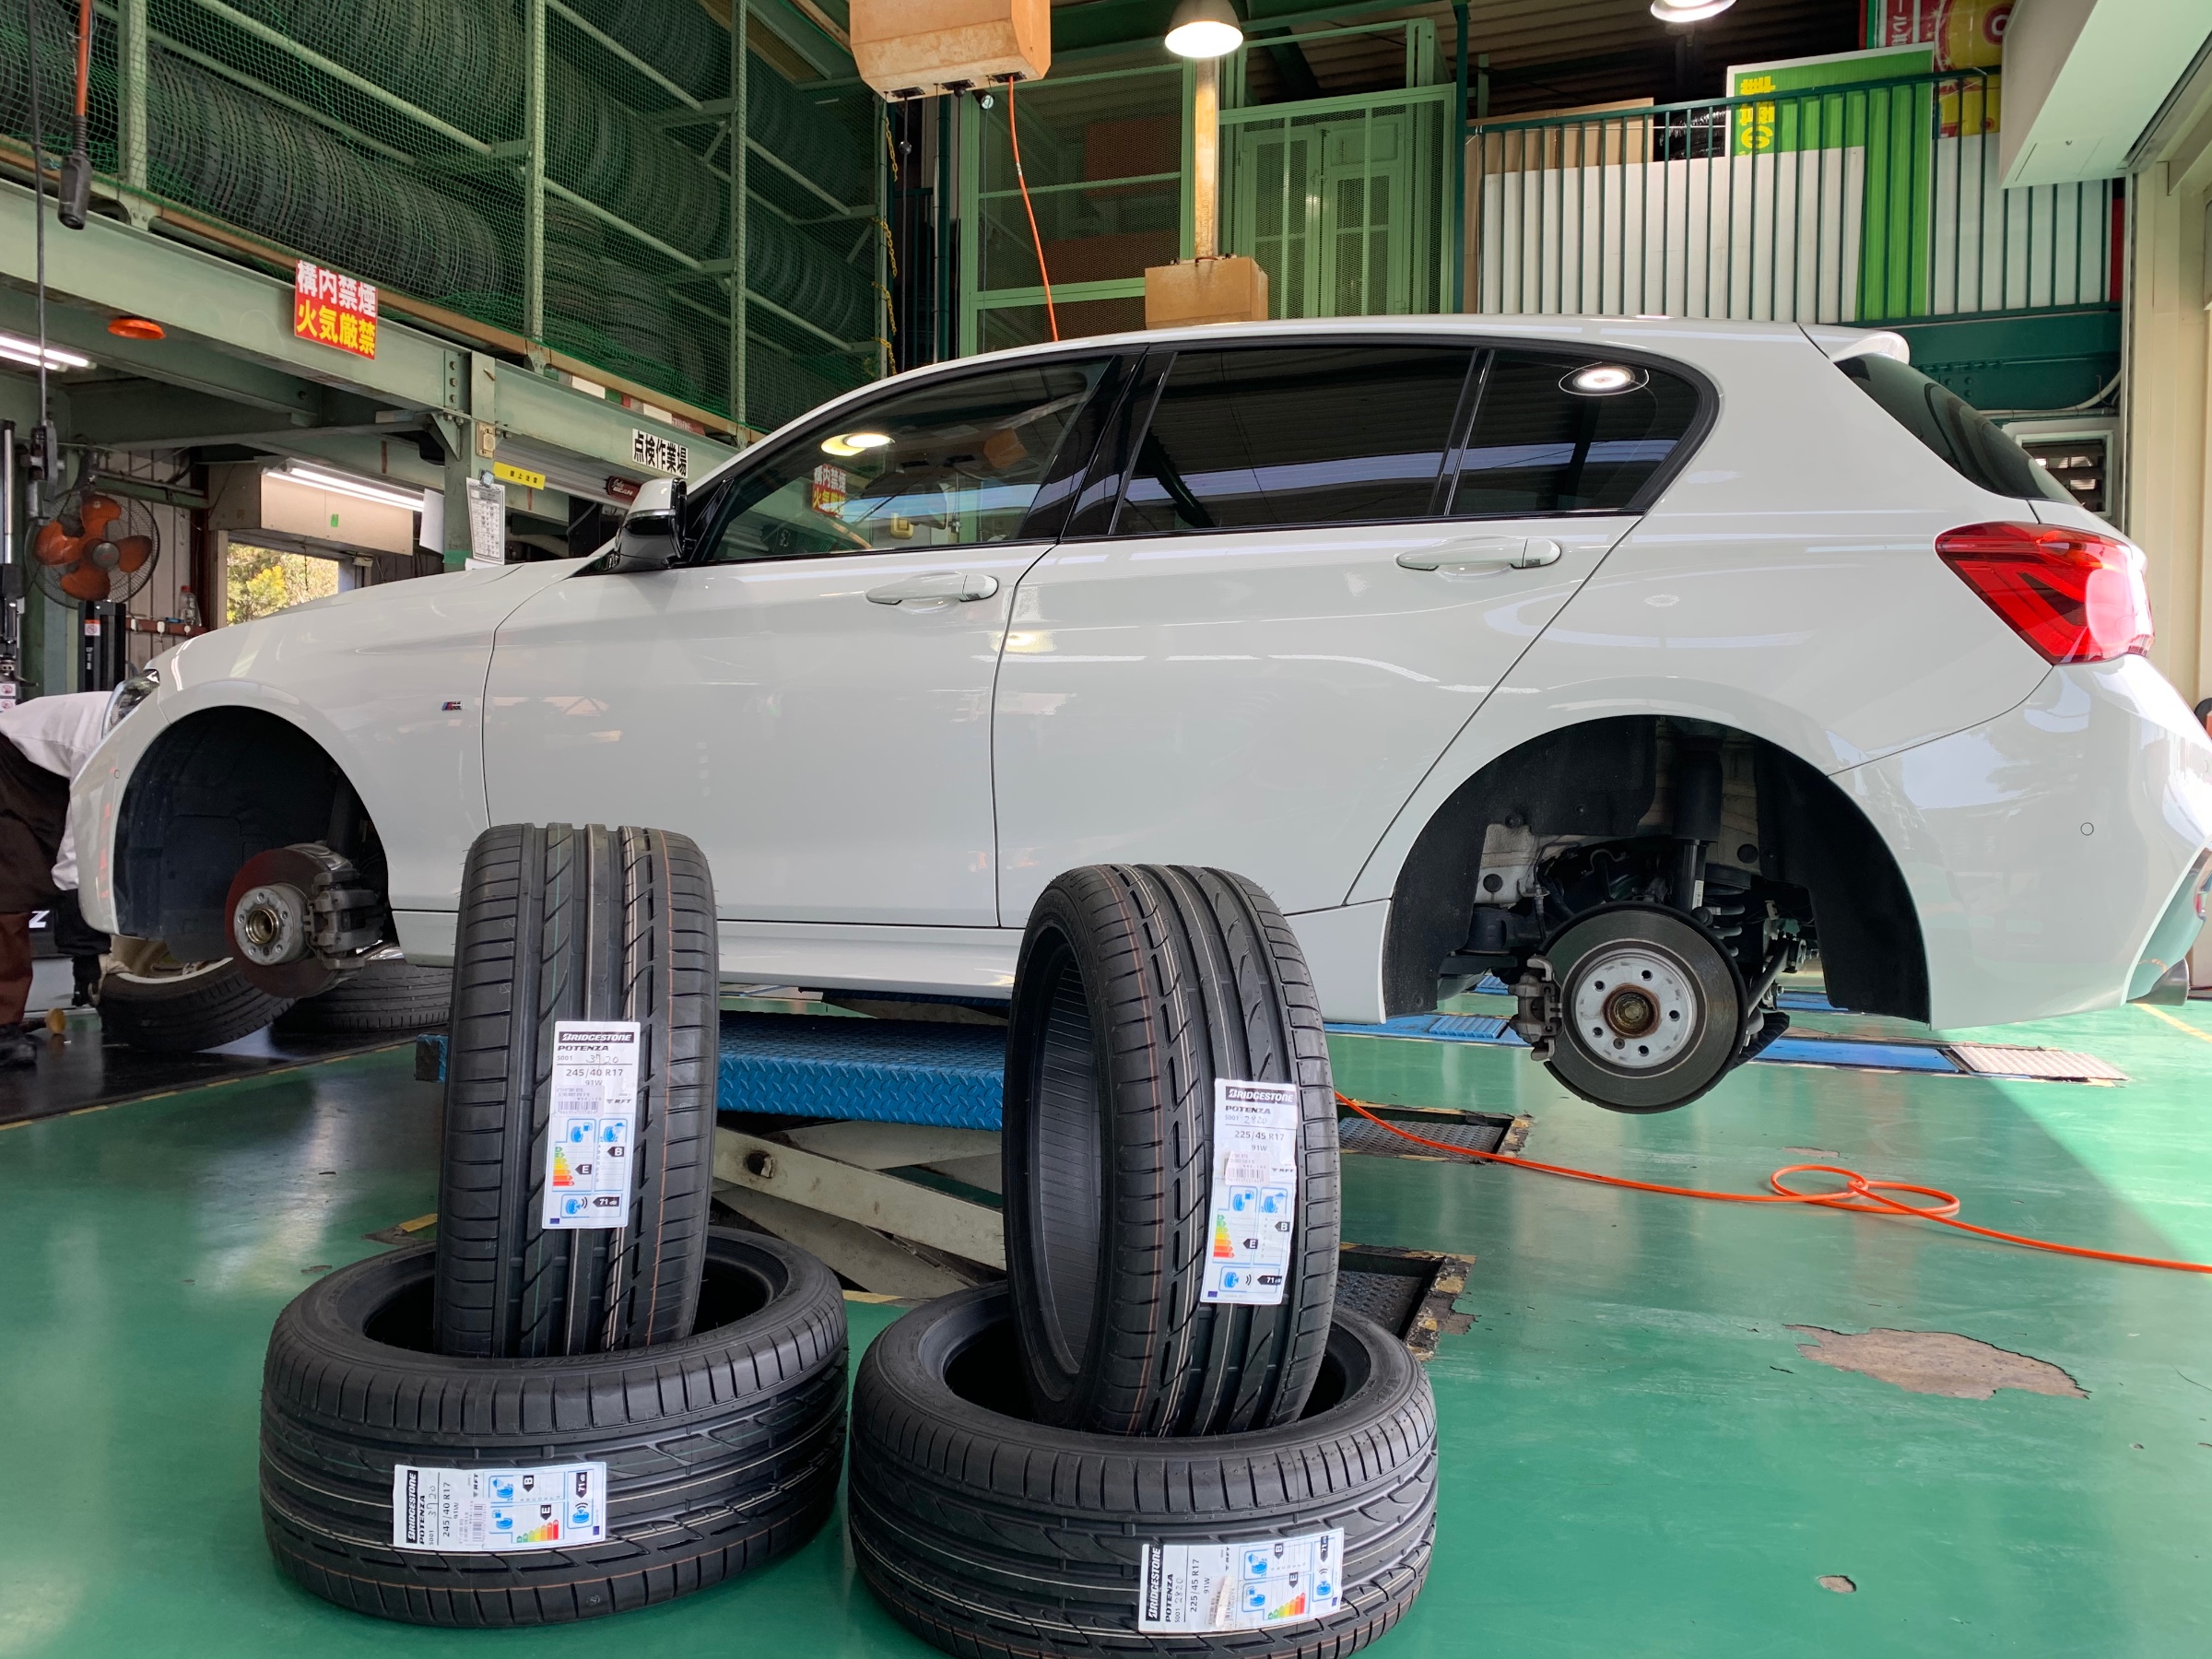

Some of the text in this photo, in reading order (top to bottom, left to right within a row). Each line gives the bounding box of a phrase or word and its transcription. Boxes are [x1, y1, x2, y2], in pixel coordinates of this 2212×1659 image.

[297, 259, 377, 318] 構内禁煙
[296, 299, 376, 356] 火気厳禁
[633, 430, 688, 477] 点検作業場
[561, 1032, 632, 1041] BRIDGESTONE
[566, 1068, 624, 1078] 245/40 R17
[1228, 1088, 1294, 1102] BRIDGESTONE
[1225, 1105, 1271, 1114] POTENZA
[1234, 1130, 1285, 1141] 225/45 R17
[614, 1147, 622, 1156] B
[1280, 1222, 1288, 1231] B
[1249, 1240, 1256, 1248] E
[524, 1477, 533, 1486] B
[578, 1482, 585, 1492] 71
[407, 1472, 417, 1541] BRIDGESTONE
[442, 1482, 452, 1537] 245/40 R17
[542, 1507, 550, 1515] E
[1276, 1545, 1283, 1553] B
[1147, 1547, 1161, 1619] BRIDGESTONE
[1190, 1559, 1200, 1612] 225/45 R17
[1165, 1573, 1173, 1622] POTENZA
